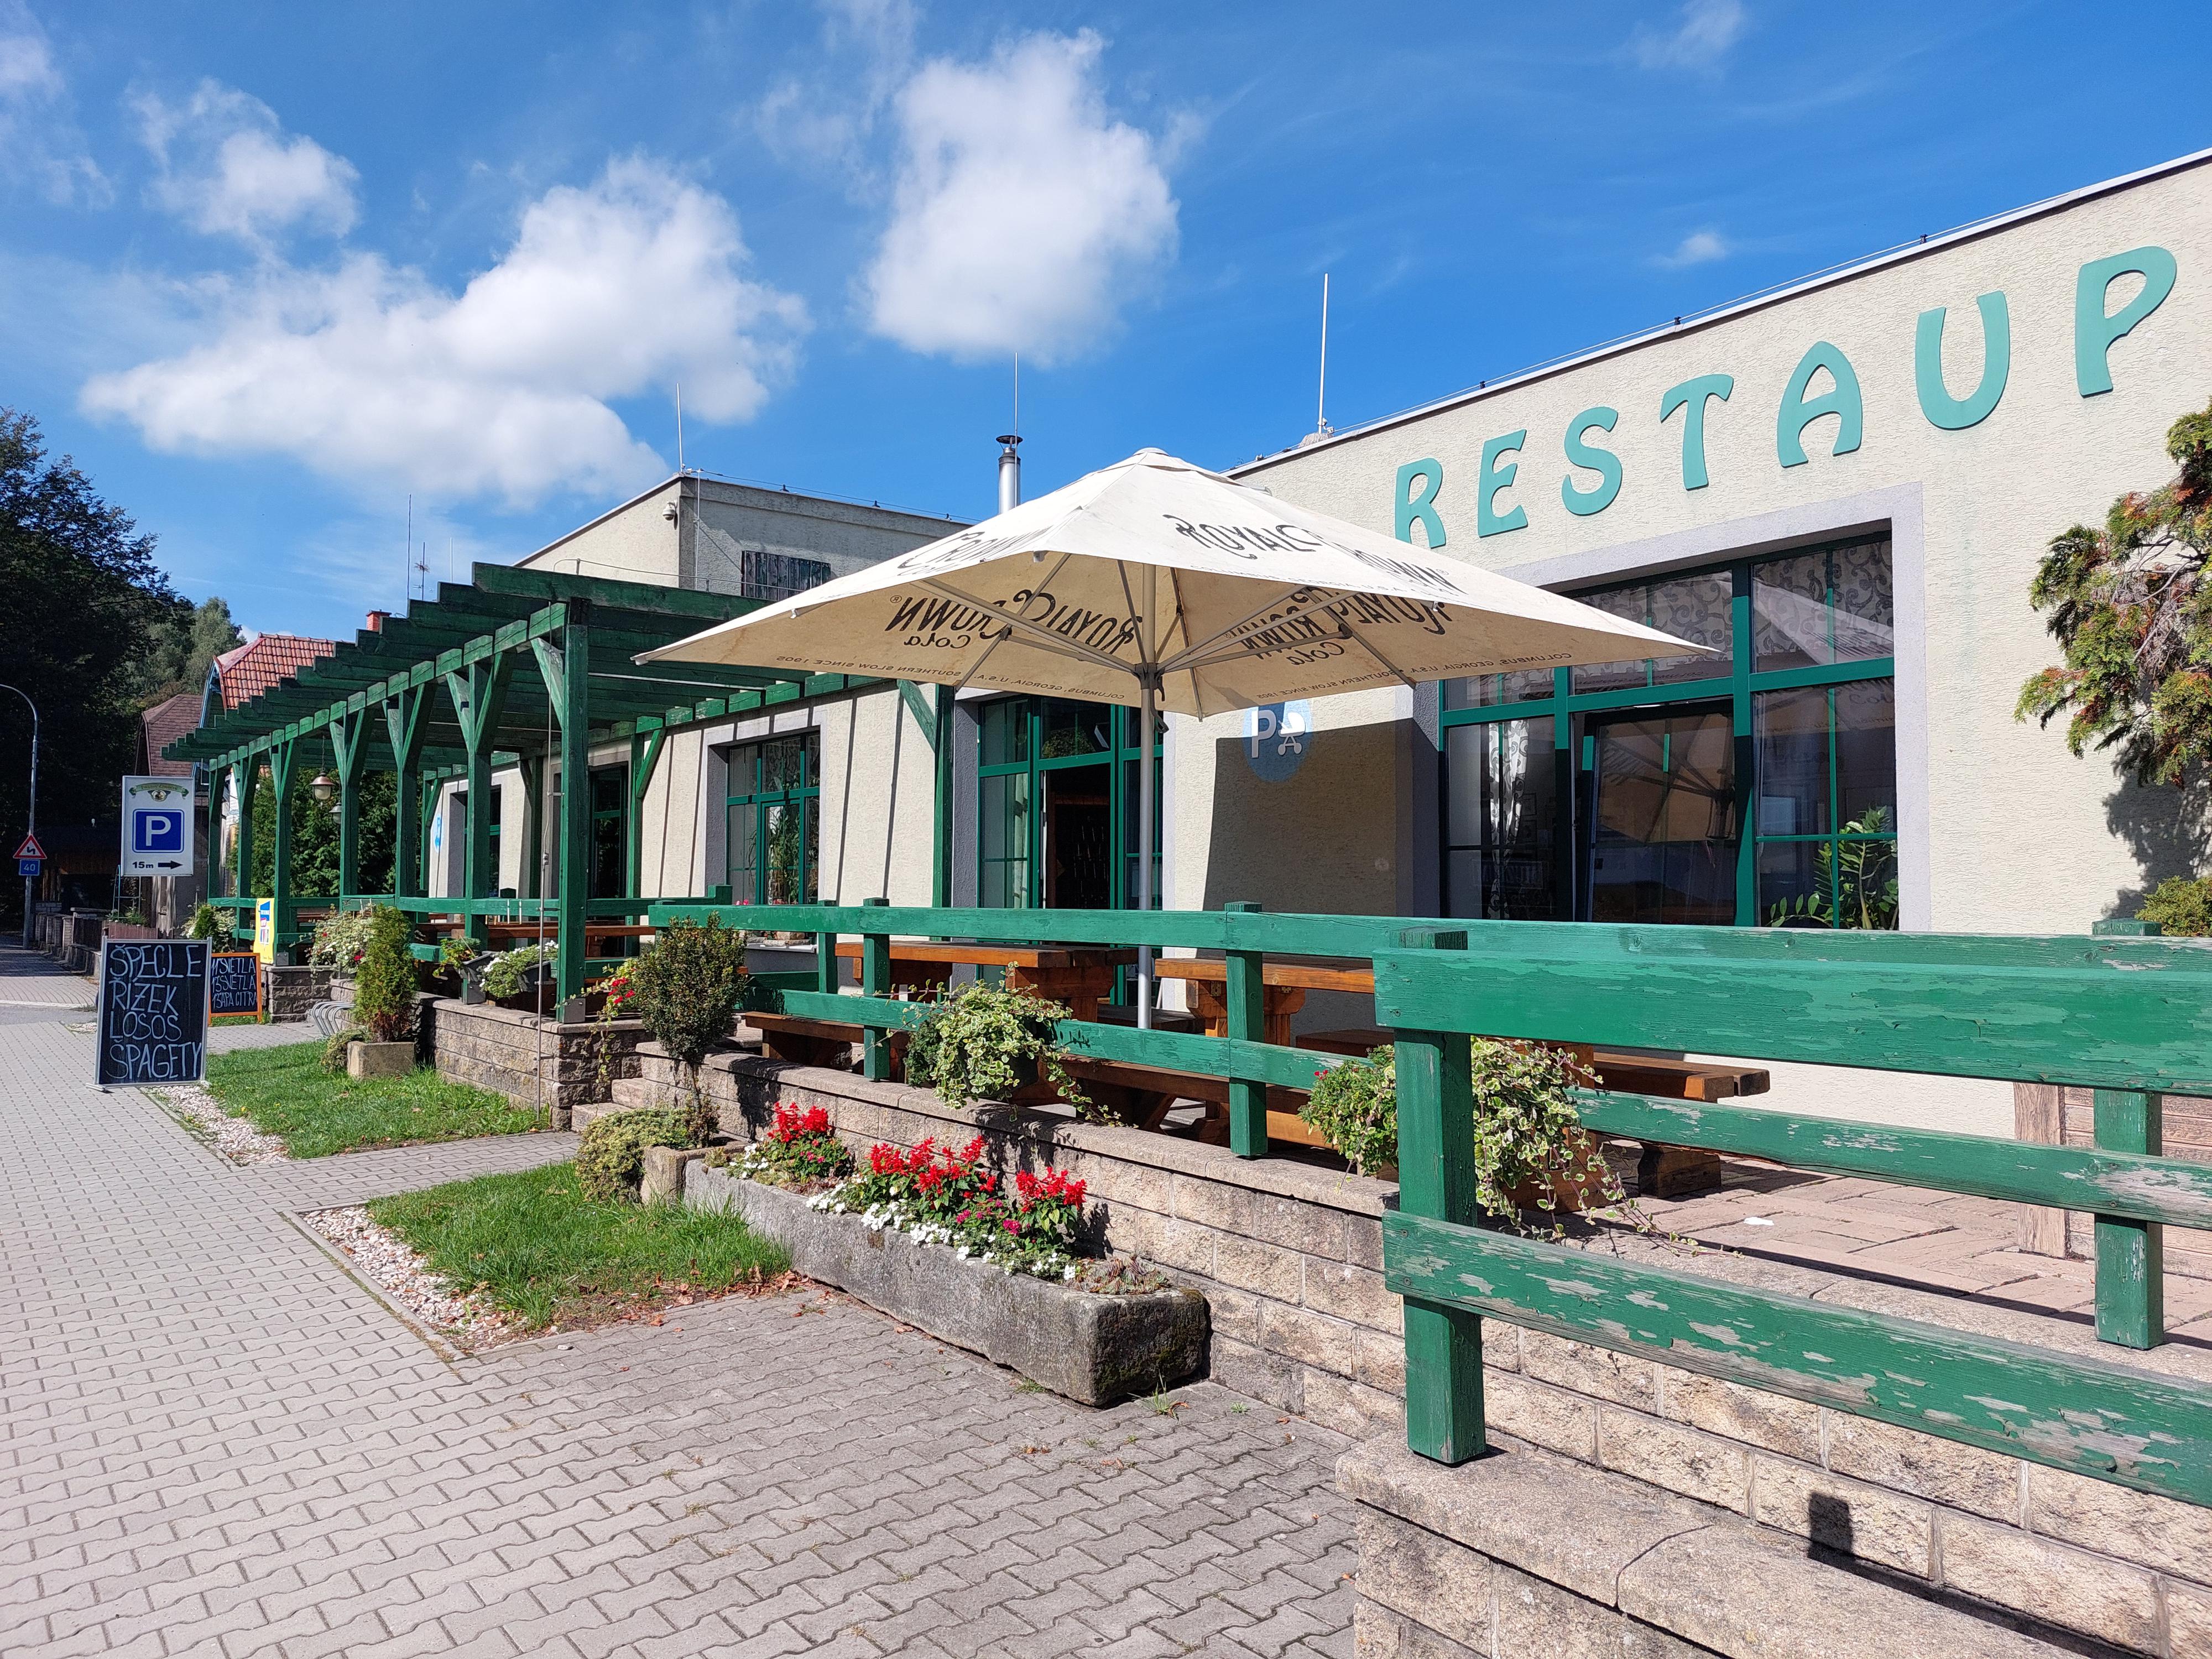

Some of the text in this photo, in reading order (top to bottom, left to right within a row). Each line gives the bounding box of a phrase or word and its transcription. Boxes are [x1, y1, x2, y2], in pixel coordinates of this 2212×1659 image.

[1162, 514, 1316, 559] ROYAL
[1251, 709, 1277, 758] P
[145, 816, 171, 847] P
[23, 863, 36, 872] 40
[108, 977, 179, 1016] ŘÍZEK
[236, 991, 258, 1006] CITRA
[109, 1011, 182, 1042] LOSOS
[106, 1039, 202, 1079] ŠPAGETY
